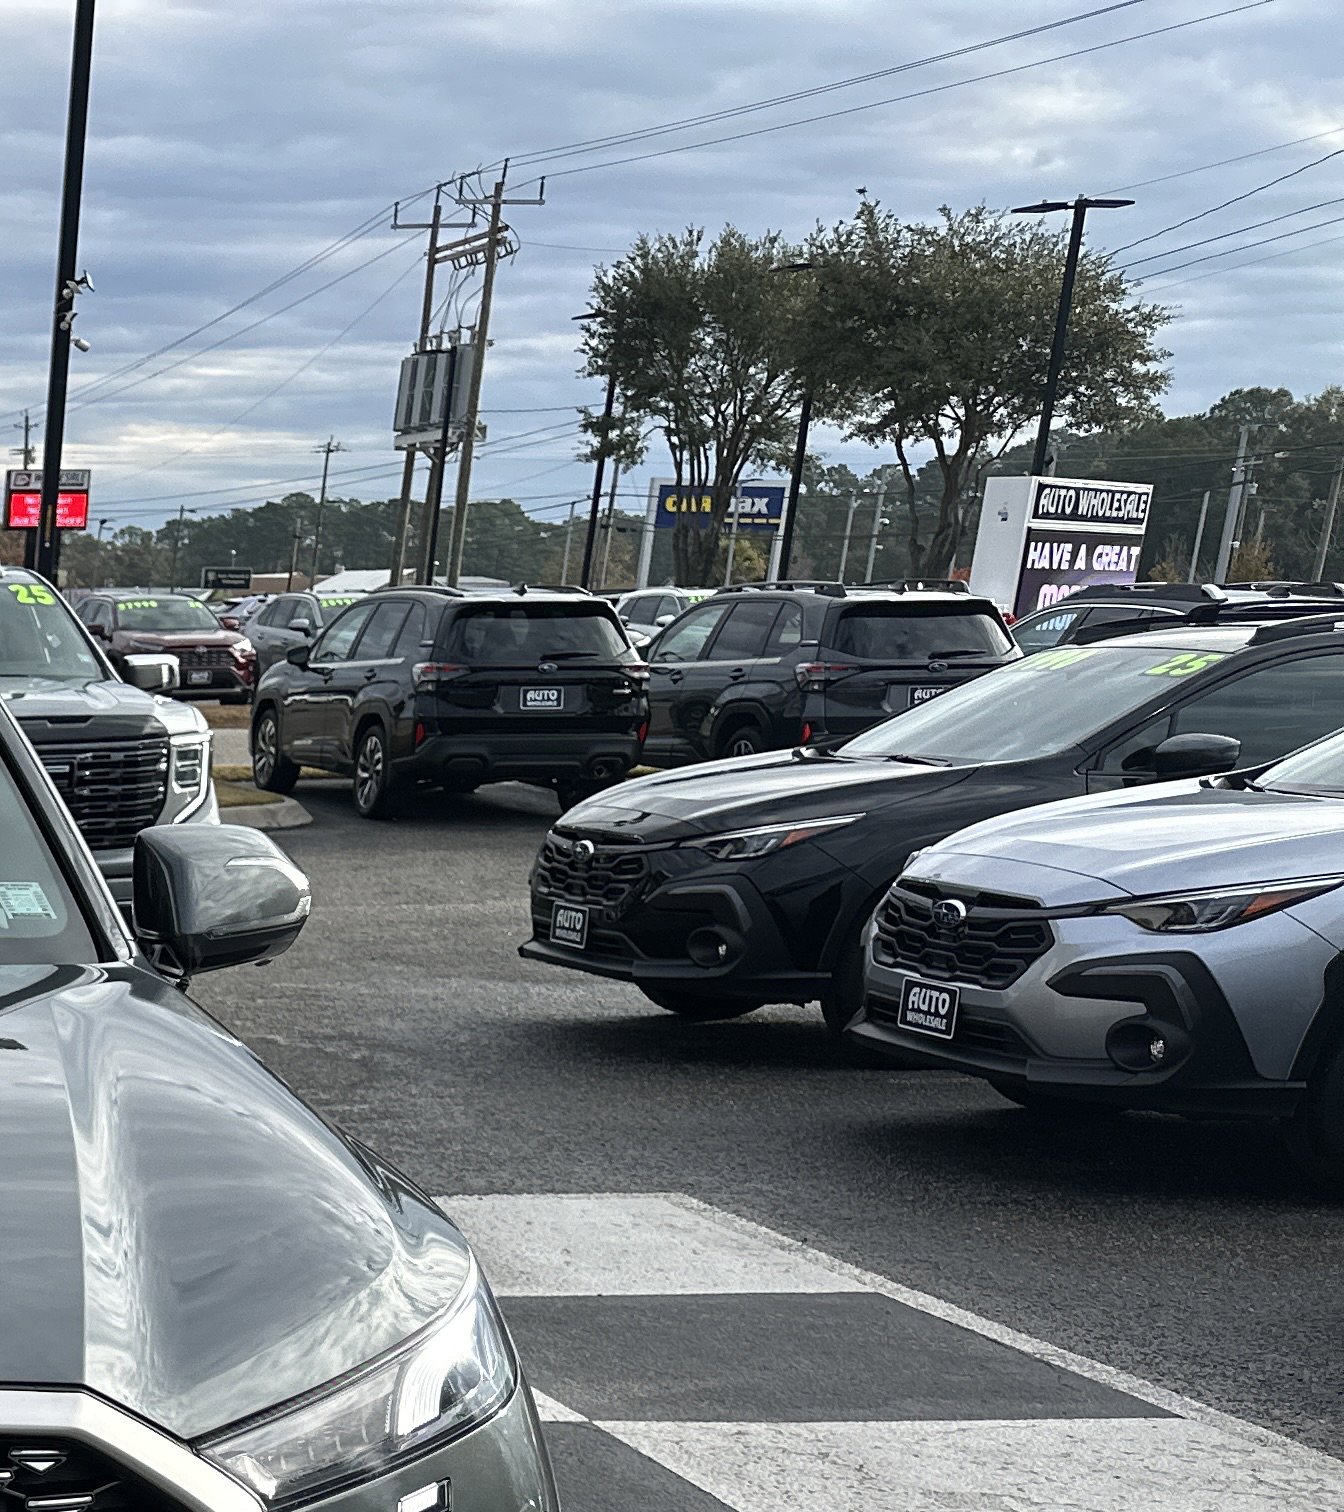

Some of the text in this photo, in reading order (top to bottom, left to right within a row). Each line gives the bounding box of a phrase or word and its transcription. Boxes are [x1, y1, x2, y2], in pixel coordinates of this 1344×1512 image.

[1038, 487, 1148, 520] AUTO WHOLESALE
[1026, 541, 1141, 572] HAVE A GREAT
[8, 584, 56, 605] 25
[1144, 653, 1225, 678] 25
[526, 689, 558, 701] AUTO
[556, 909, 583, 930] AUTO
[908, 986, 951, 1016] AUTO
